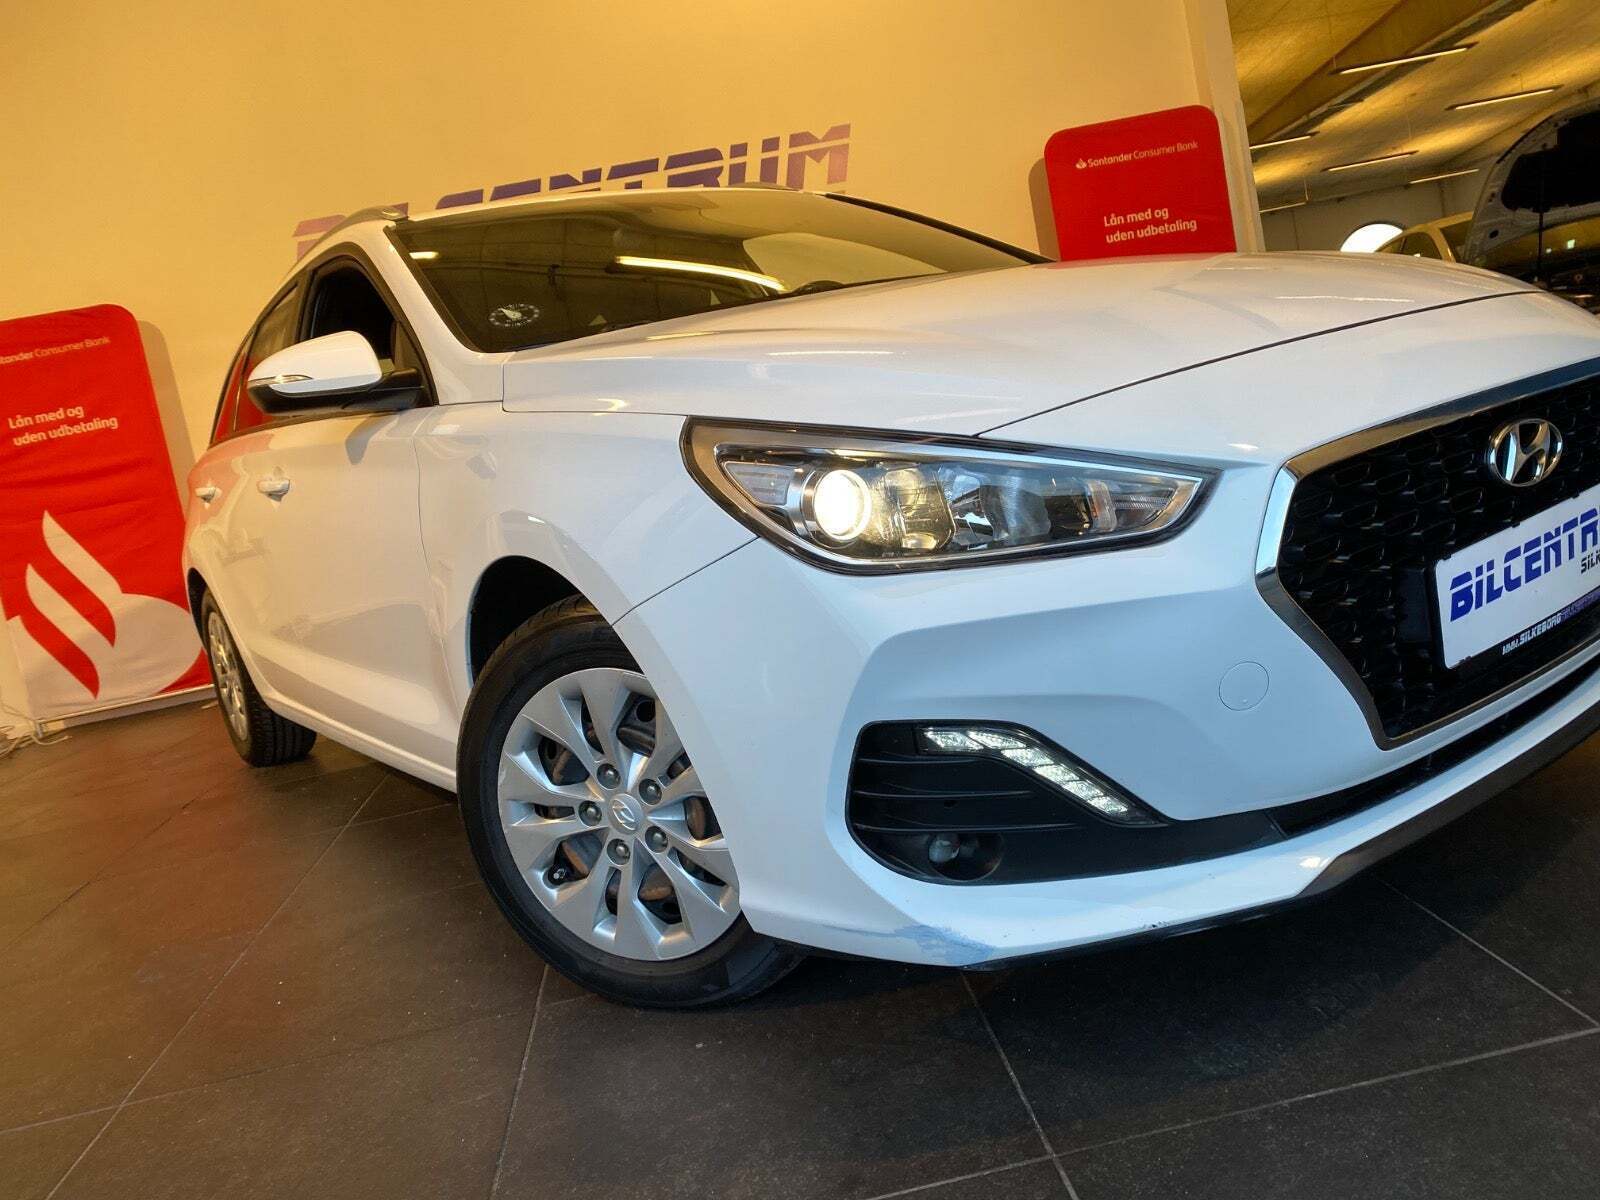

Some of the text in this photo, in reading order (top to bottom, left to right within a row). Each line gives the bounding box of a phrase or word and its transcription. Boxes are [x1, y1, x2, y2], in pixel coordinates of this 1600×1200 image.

[1087, 140, 1199, 168] Santander Consumer Bank
[1103, 207, 1169, 227] Lån med og
[1106, 218, 1197, 243] uden udbetaling
[34, 342, 83, 357] Consumer
[84, 336, 110, 348] Bank
[8, 405, 84, 429] Lån med og
[13, 417, 118, 446] uden udbetaling
[1450, 507, 1600, 623] BILCENTR
